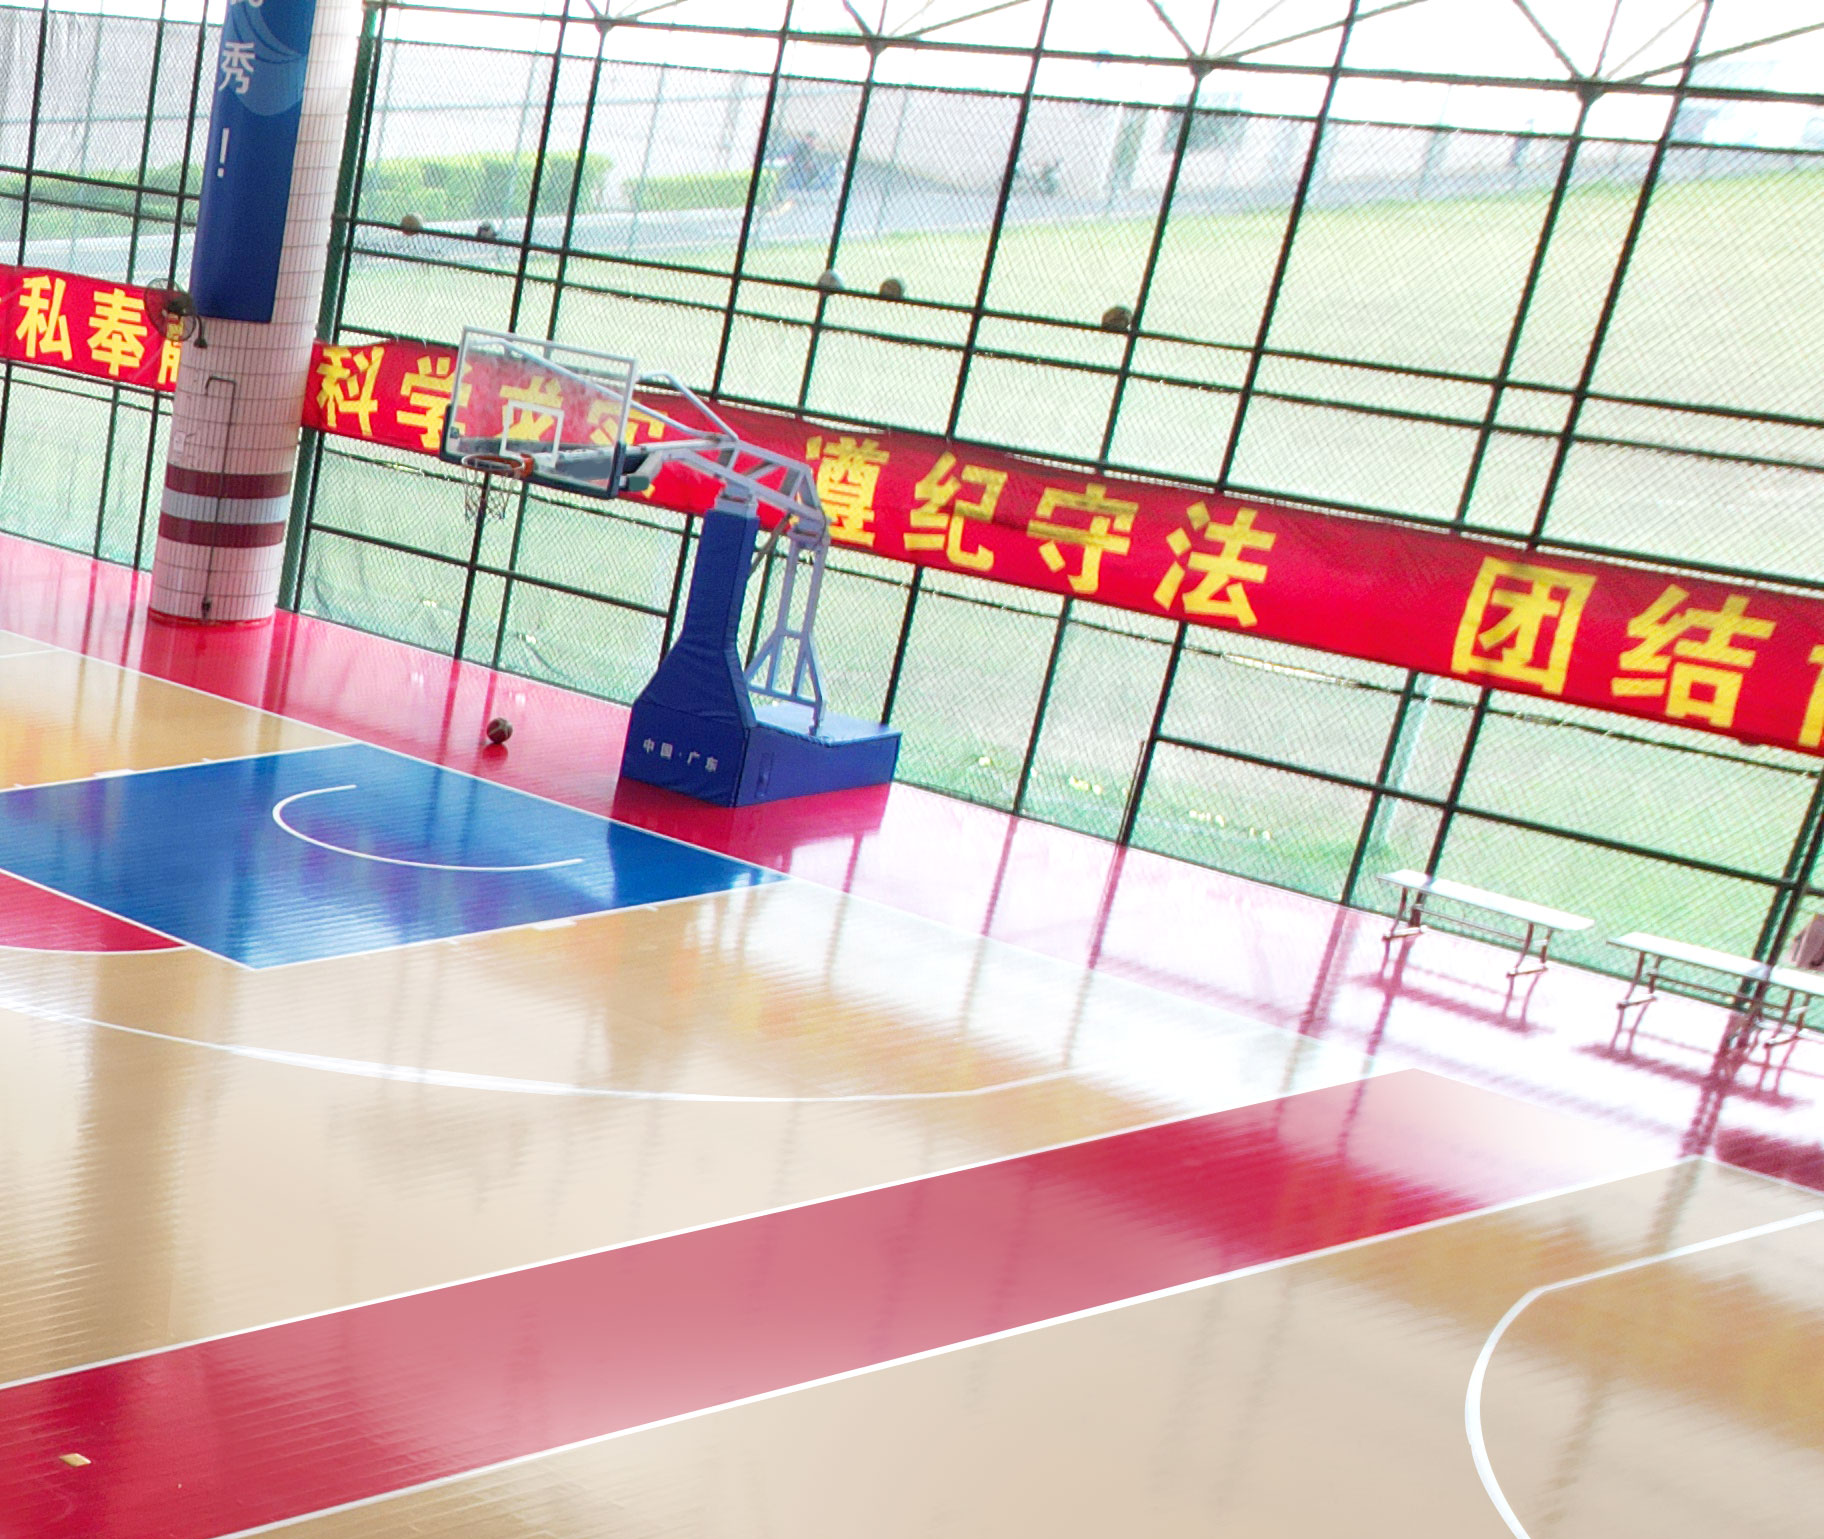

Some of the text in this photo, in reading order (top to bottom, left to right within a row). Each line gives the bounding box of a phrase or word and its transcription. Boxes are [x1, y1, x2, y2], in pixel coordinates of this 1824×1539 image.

[216, 0, 264, 179] 秀！
[789, 436, 1277, 627] 遵纪守法
[1451, 556, 1824, 747] 团结
